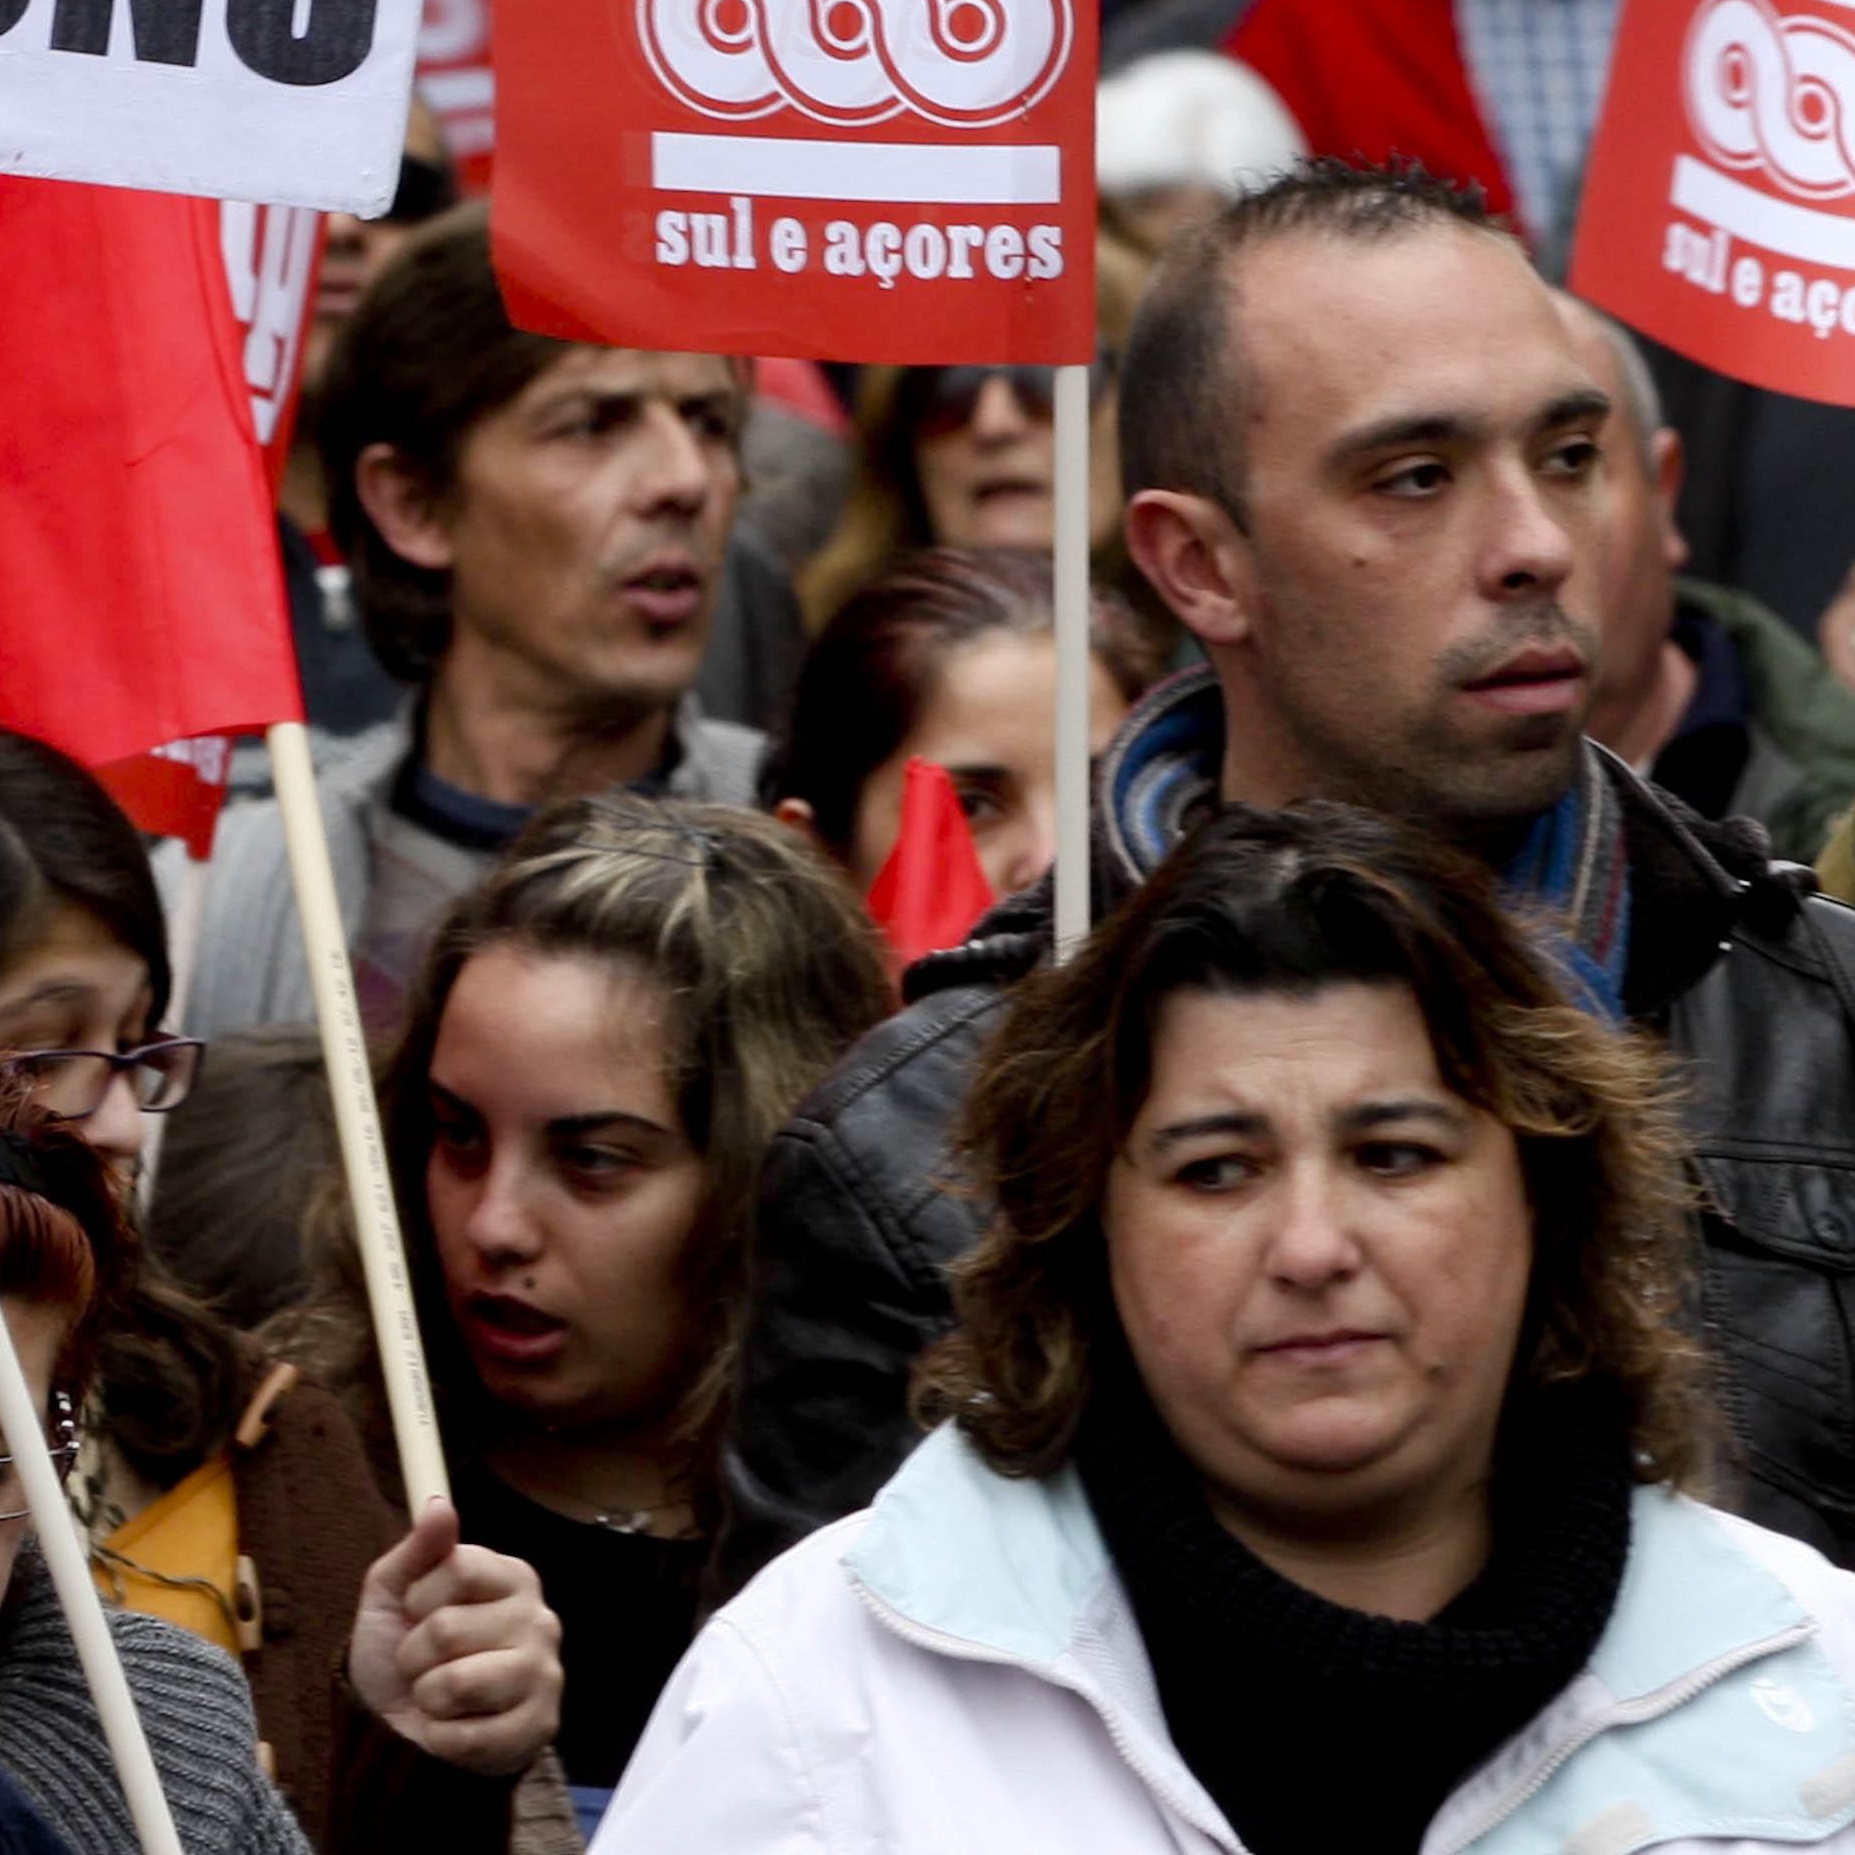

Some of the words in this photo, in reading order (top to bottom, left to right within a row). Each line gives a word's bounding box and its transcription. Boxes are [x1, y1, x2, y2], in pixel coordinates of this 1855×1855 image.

[655, 196, 757, 270] sul
[770, 216, 808, 274] e
[823, 220, 1065, 289] açores
[1662, 222, 1731, 294] sul
[1731, 256, 1764, 307] e
